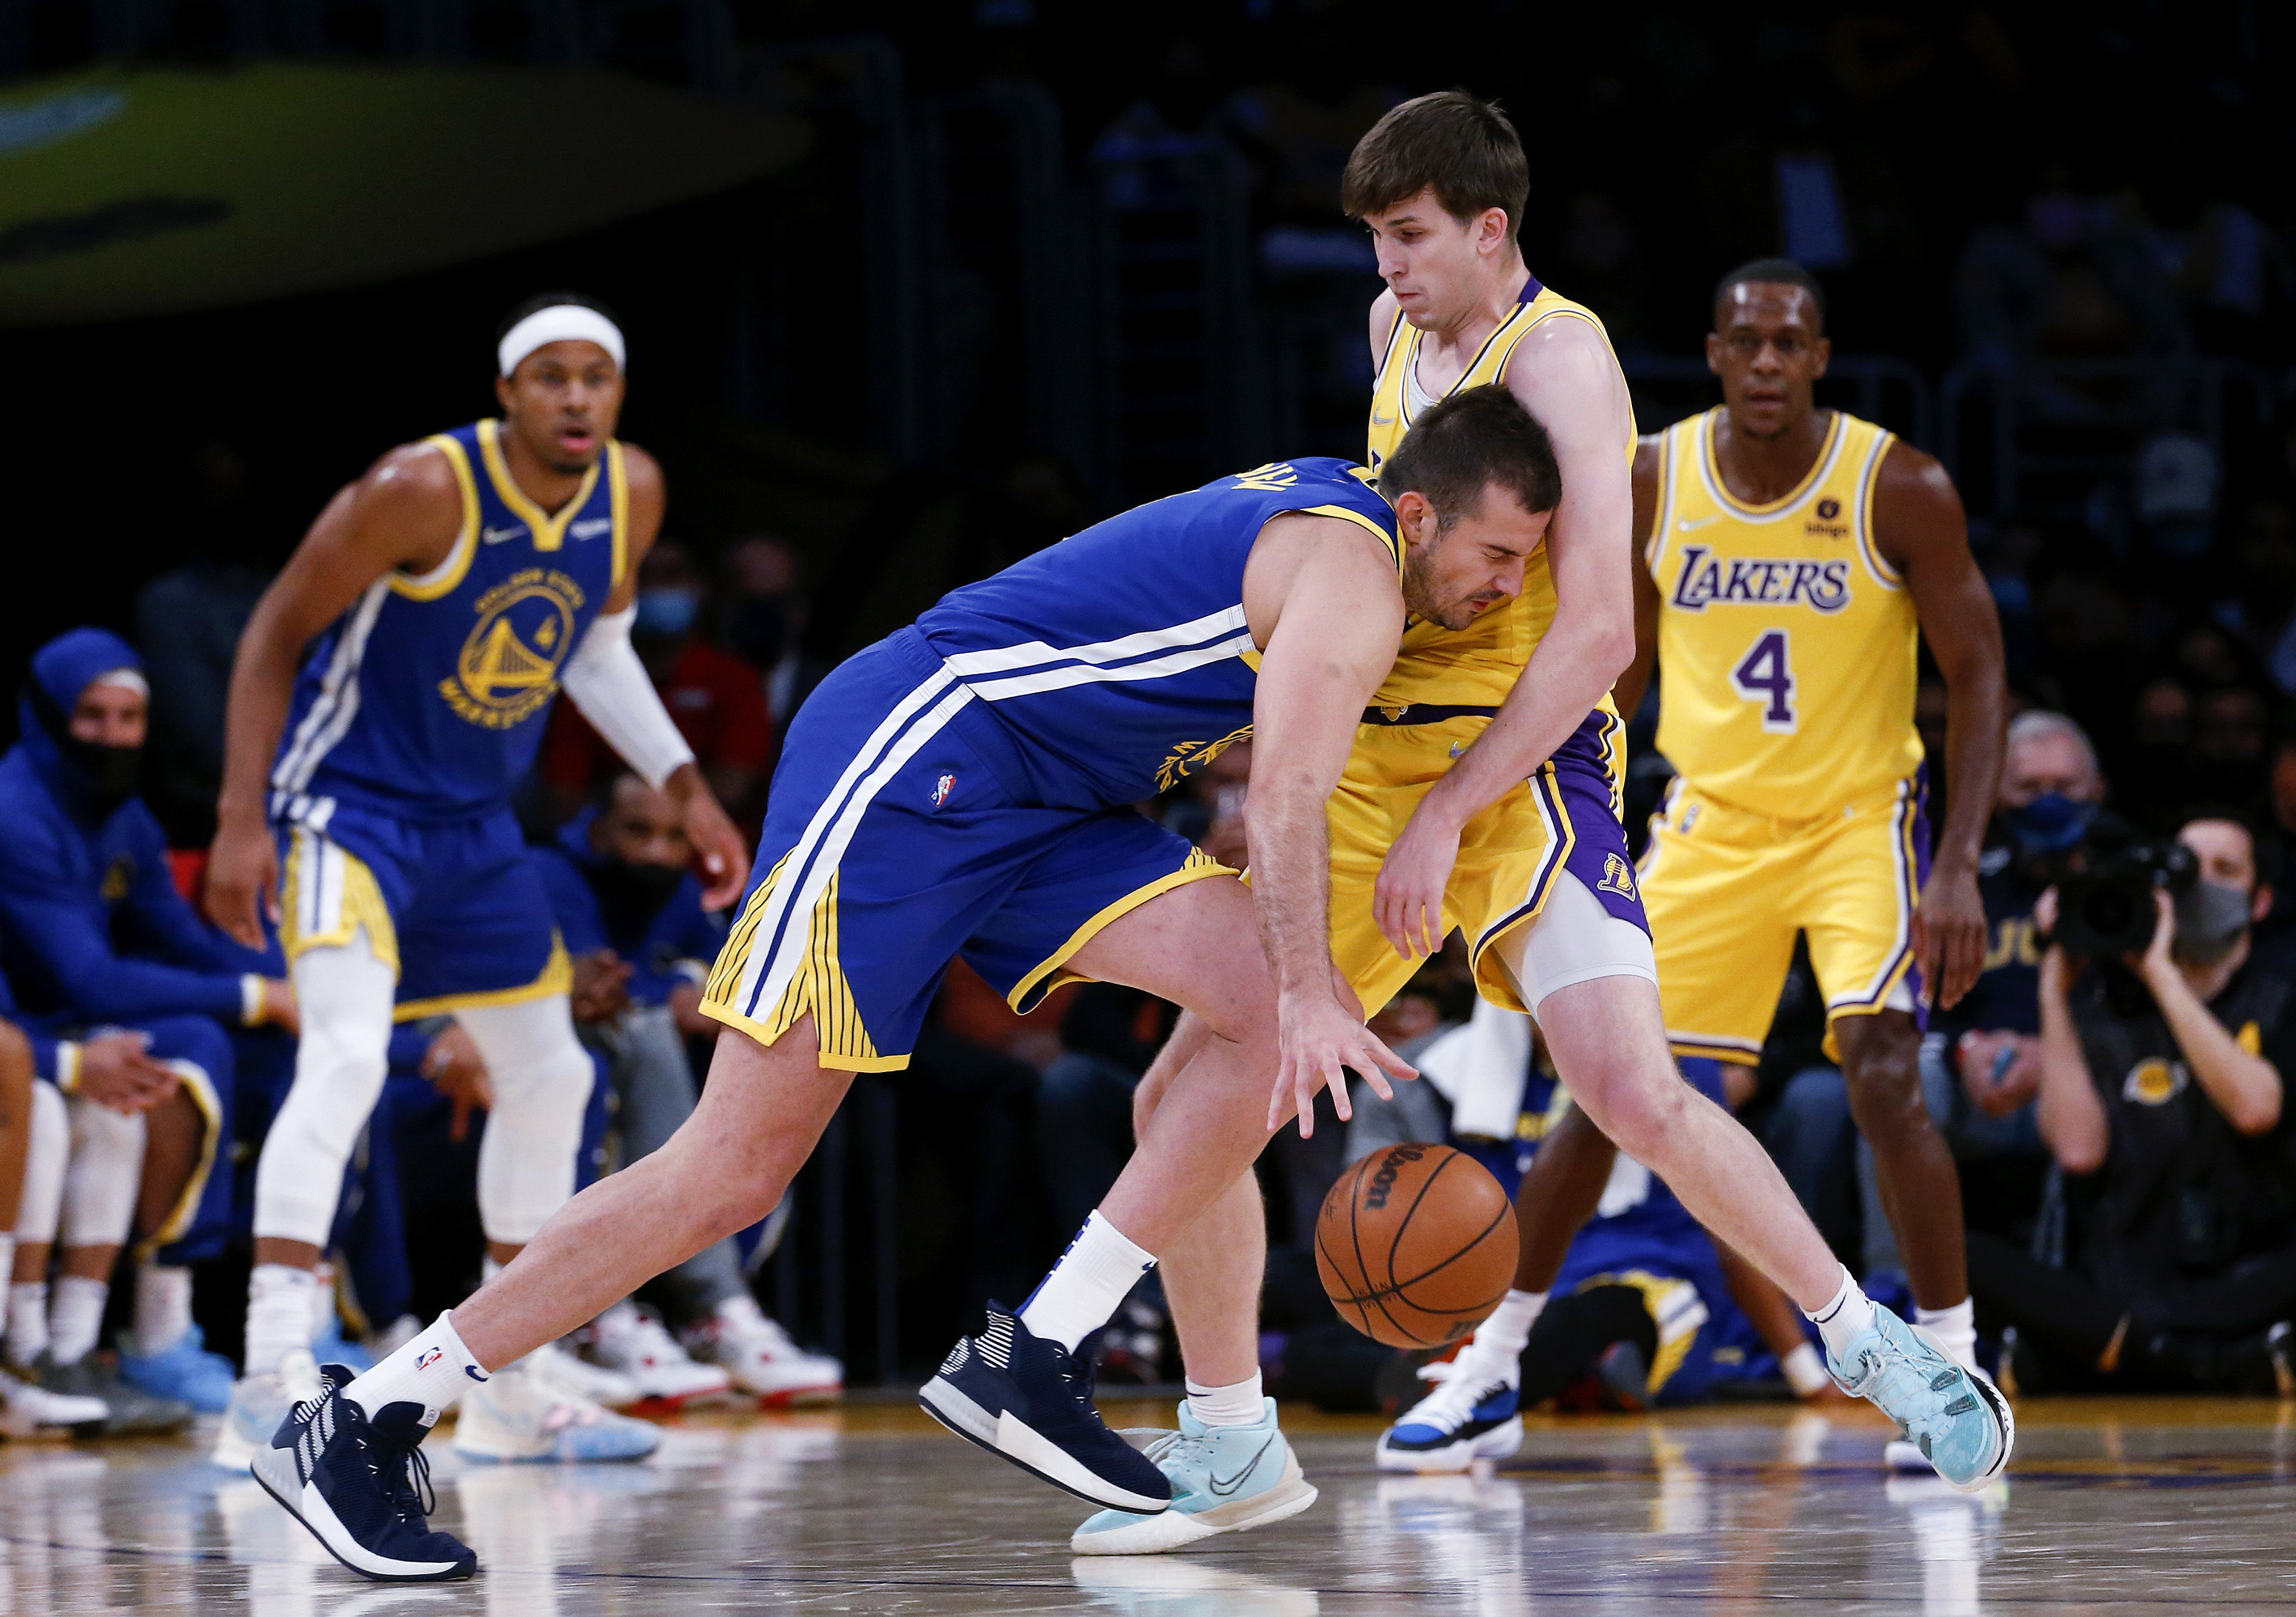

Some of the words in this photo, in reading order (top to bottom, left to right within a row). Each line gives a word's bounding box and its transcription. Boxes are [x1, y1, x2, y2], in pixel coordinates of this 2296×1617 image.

[1672, 547, 1851, 614] LAKERS
[1731, 629, 1796, 733] 4
[1364, 1142, 1434, 1210] ilson
